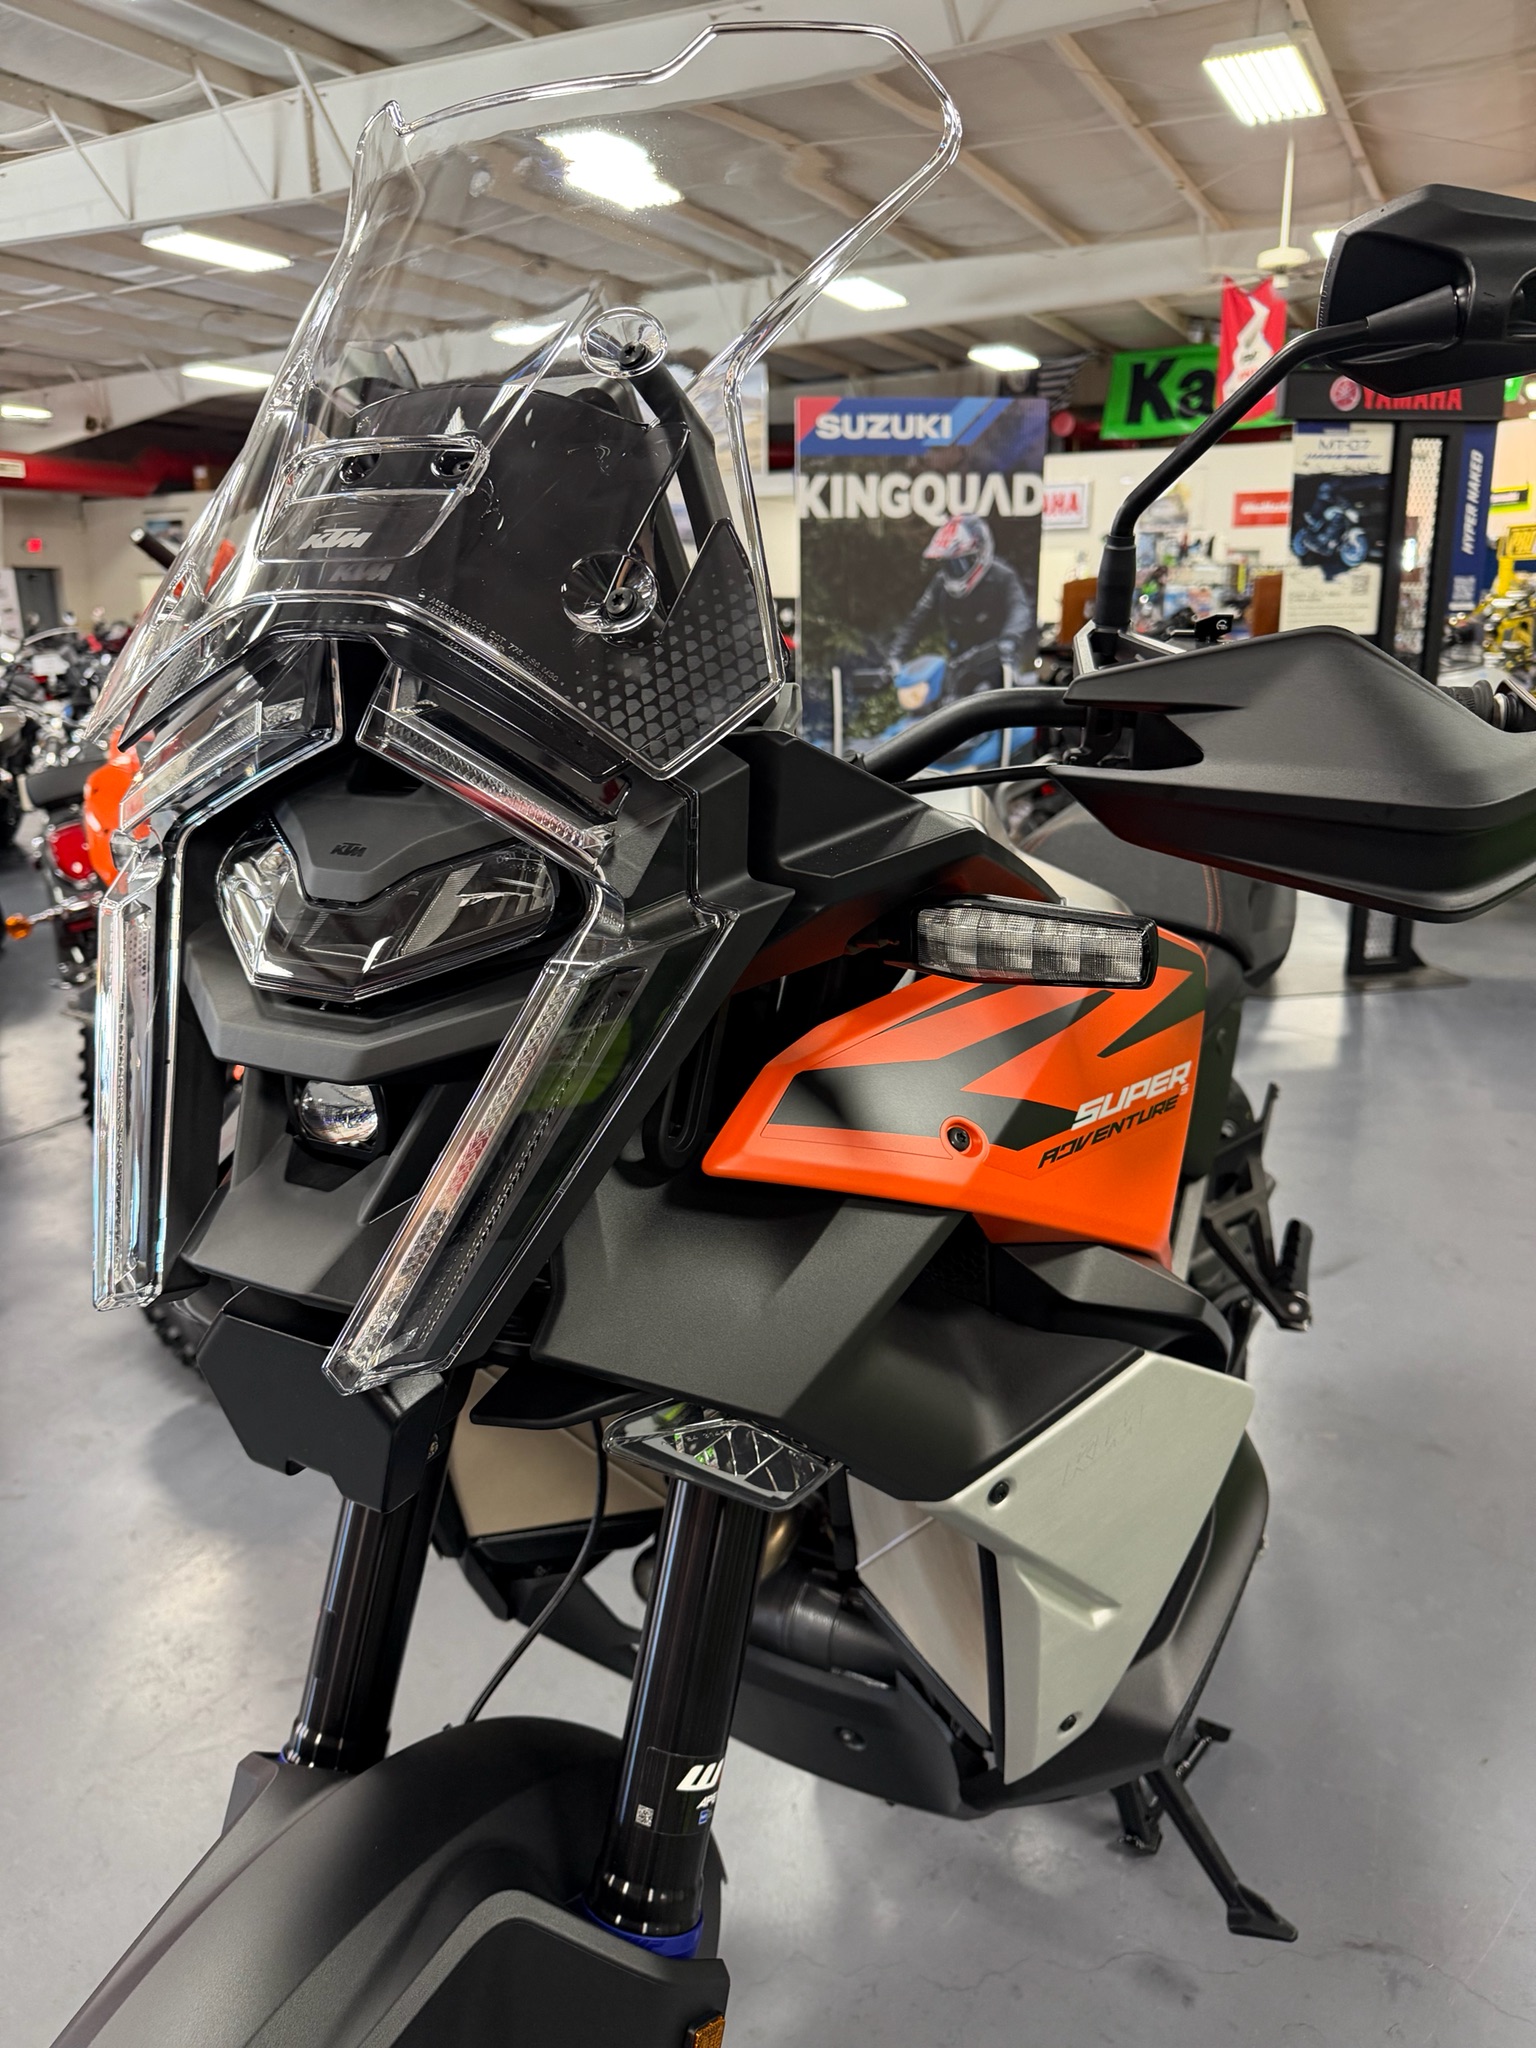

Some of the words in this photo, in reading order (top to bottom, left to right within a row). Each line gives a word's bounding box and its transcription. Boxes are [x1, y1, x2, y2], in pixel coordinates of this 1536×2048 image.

[815, 411, 952, 441] SUZUKI
[798, 471, 1044, 527] KINGQUAD
[1466, 449, 1485, 504] NAKED
[297, 527, 373, 550] KTM
[1461, 502, 1479, 555] HYPER
[330, 842, 368, 857] KTM
[1071, 1060, 1192, 1131] SUPER
[1037, 1094, 1180, 1169] ADVENTURE
[1179, 1083, 1190, 1096] S
